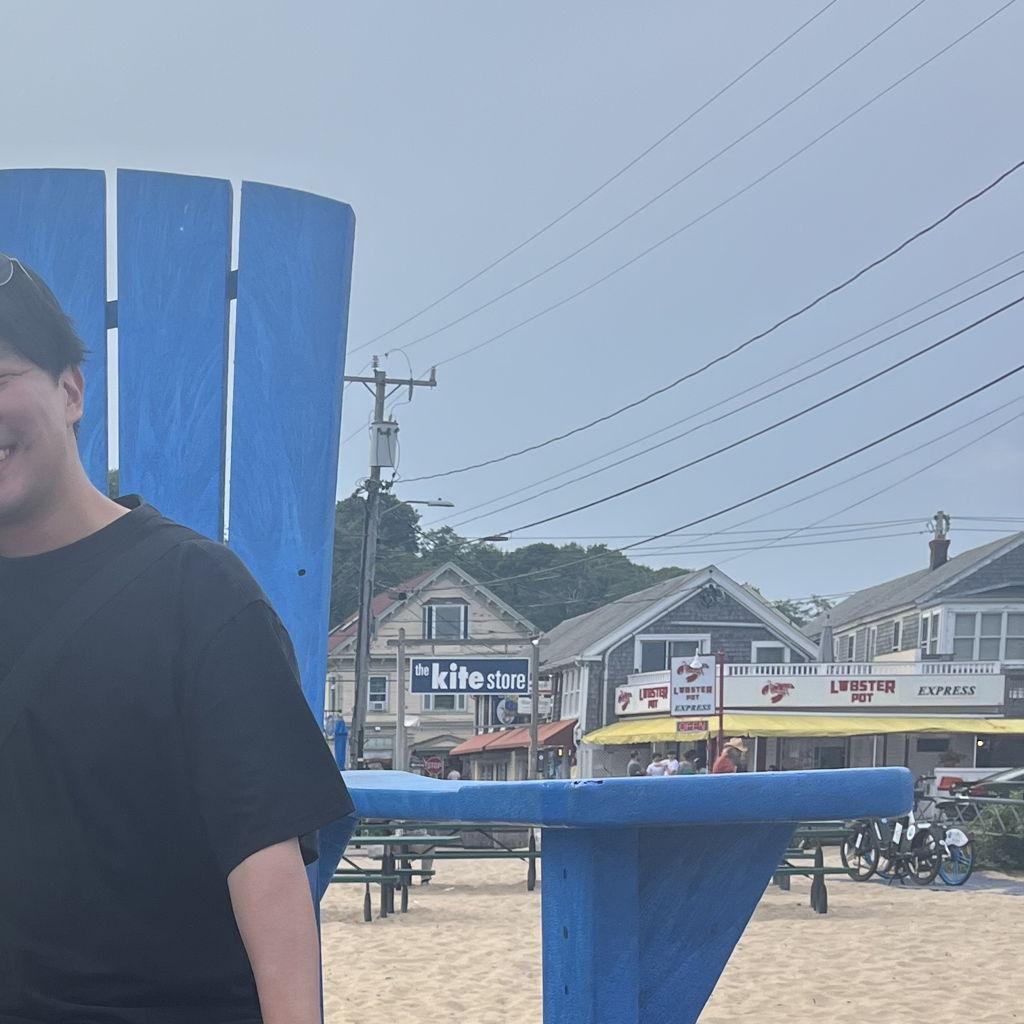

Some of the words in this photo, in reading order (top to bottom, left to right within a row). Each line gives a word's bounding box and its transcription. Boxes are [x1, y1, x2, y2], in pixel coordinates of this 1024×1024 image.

[414, 663, 429, 676] the
[431, 662, 485, 689] kite
[486, 670, 526, 689] store
[673, 686, 713, 695] LOBSTER
[830, 680, 896, 694] LOBSTER
[917, 685, 976, 696] EXPRESS
[639, 687, 668, 701] LOBSTER
[851, 693, 874, 703] POT
[674, 704, 711, 712] EXPRESS
